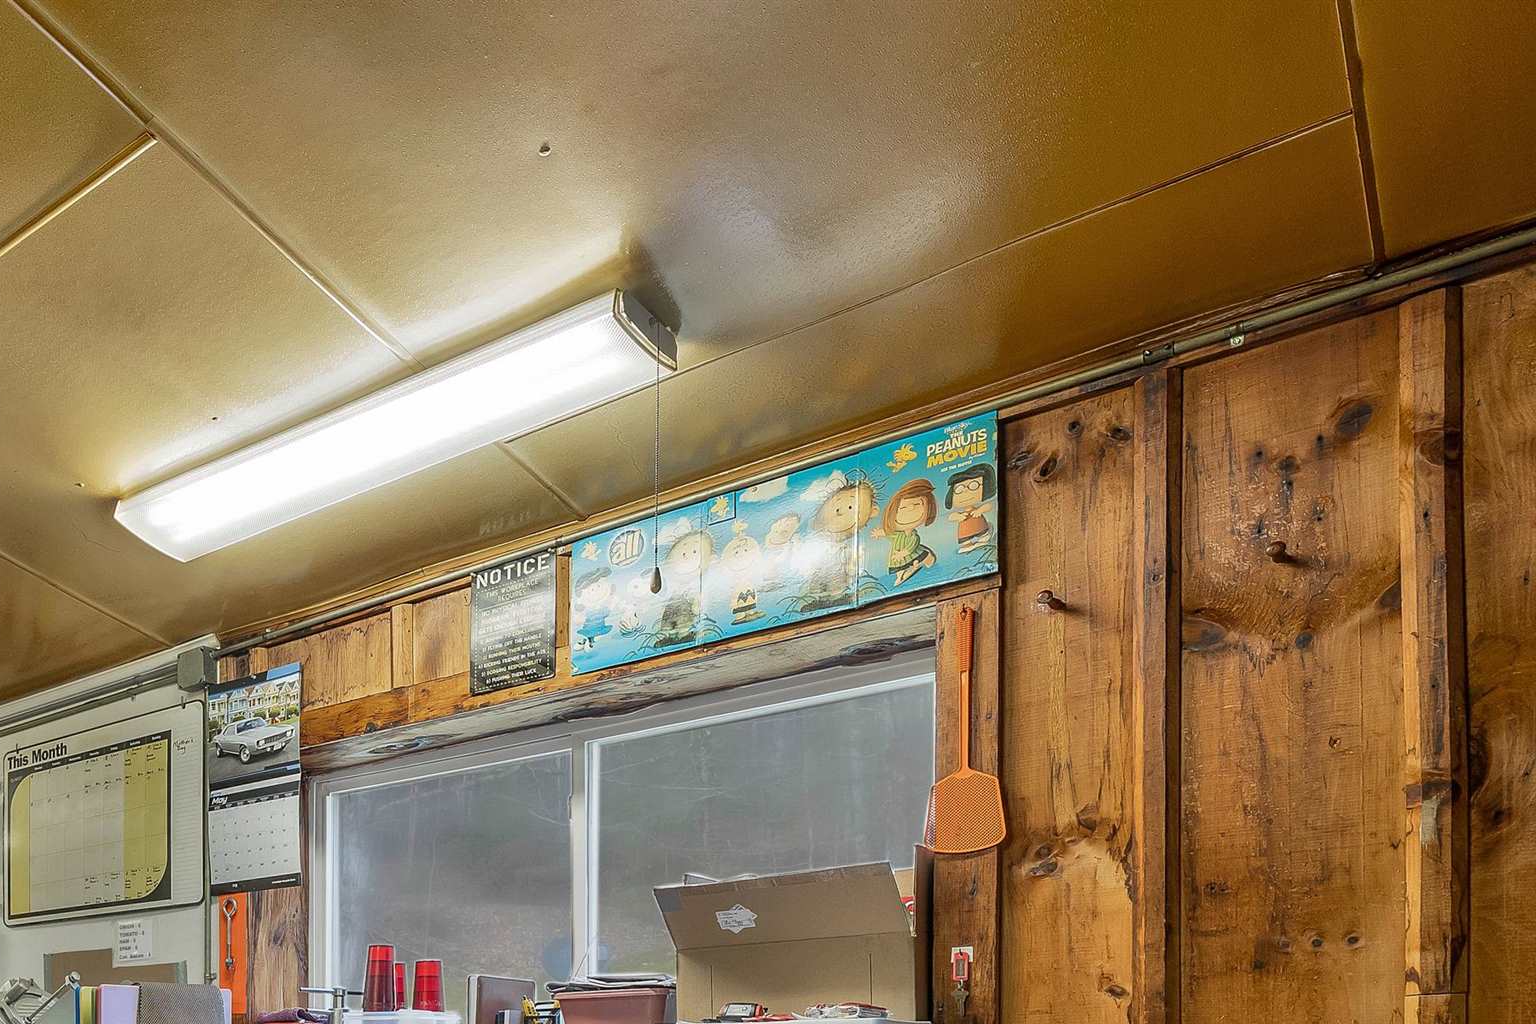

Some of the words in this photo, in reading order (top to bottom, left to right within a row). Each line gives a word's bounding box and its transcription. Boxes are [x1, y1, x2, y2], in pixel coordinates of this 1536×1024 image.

[927, 429, 987, 456] PEANUTS
[927, 441, 987, 468] MOVIE
[611, 530, 641, 565] all
[476, 553, 550, 589] NOTICE
[502, 577, 537, 593] WORKPLACE
[525, 667, 536, 675] LUCK
[8, 756, 29, 770] This
[32, 743, 67, 764] Month
[212, 796, 228, 806] May
